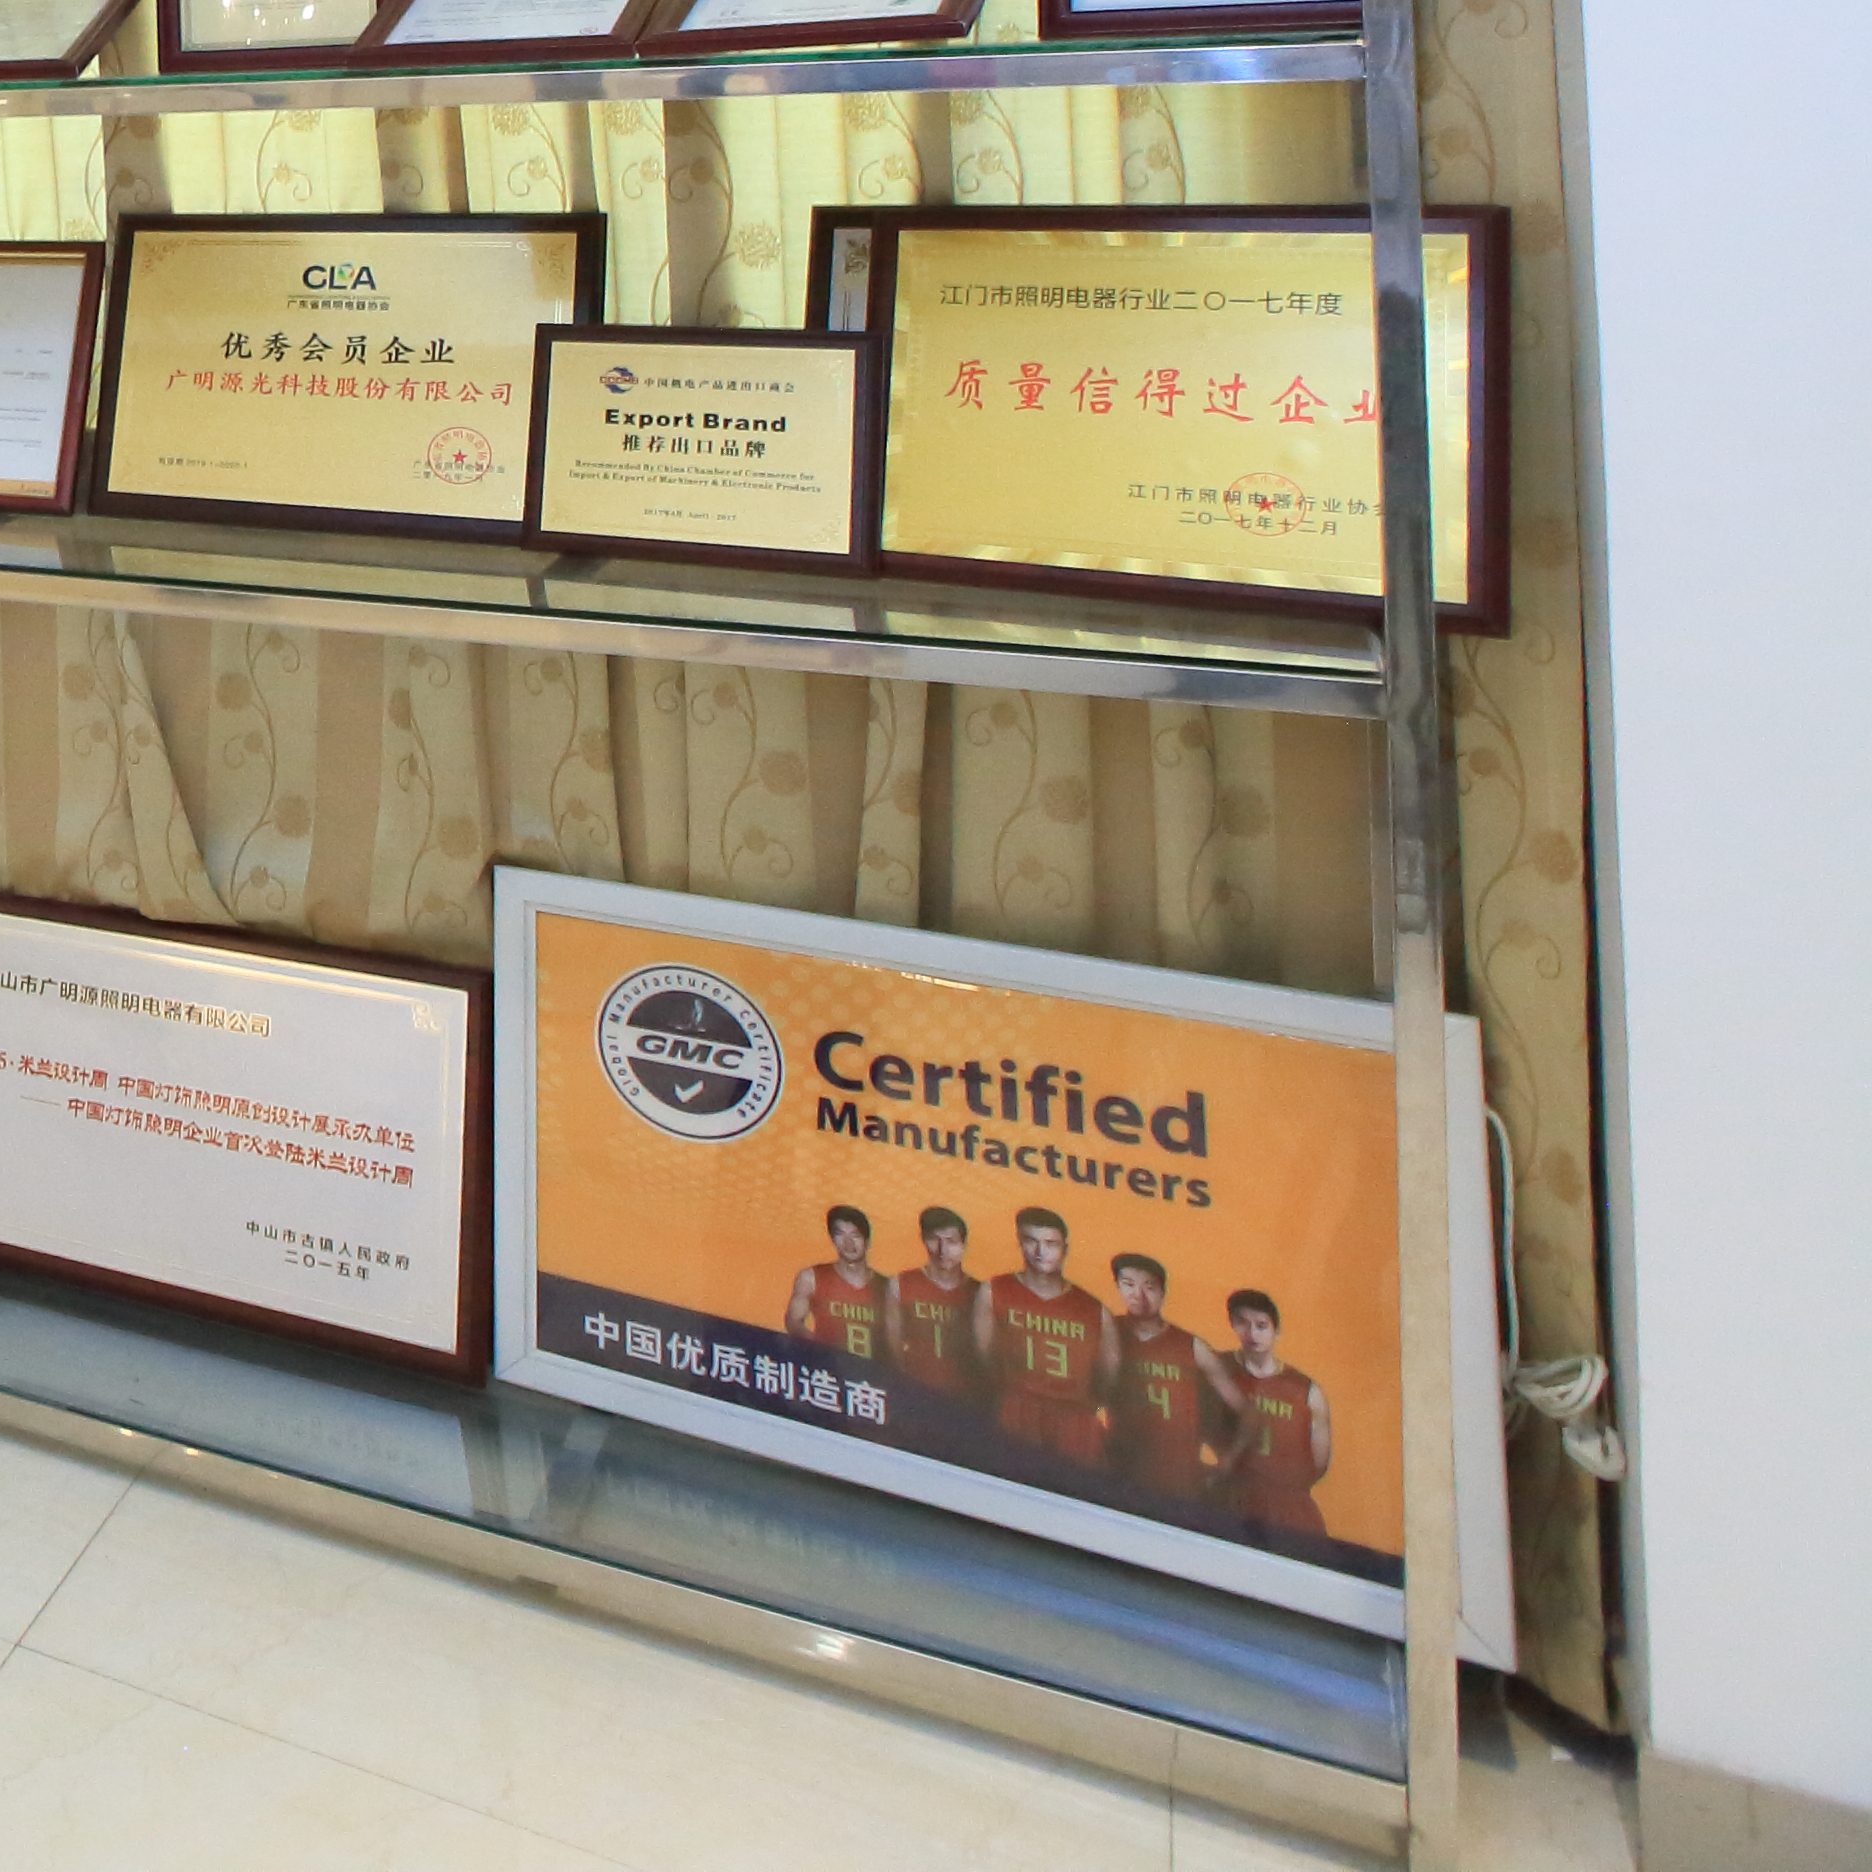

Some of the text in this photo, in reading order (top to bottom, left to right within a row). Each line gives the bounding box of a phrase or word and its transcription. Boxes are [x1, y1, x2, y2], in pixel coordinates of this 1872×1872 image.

[288, 300, 390, 312] 广东省照明电器协会
[222, 332, 455, 365] 优秀会员企业
[165, 370, 514, 406] 广明源光科技股份有限公司
[644, 378, 795, 393] 中国机电产品进出口商会
[605, 409, 787, 433] Export Brand
[622, 433, 766, 459] 推荐出口品牌
[608, 975, 732, 1024] Manufacturer
[607, 1035, 640, 1097] Global
[636, 1035, 744, 1070] GMC
[813, 1029, 1209, 1159] Certified
[117, 1074, 416, 1153] 中国灯饰照明原创设计展承办单位
[814, 1096, 1213, 1210] Manufacturers
[246, 1219, 411, 1273] 中山市古镇人民政府
[847, 1324, 872, 1359] 8
[1008, 1308, 1086, 1342] CHINA
[583, 1309, 888, 1426] 中国优质制造商
[1025, 1335, 1068, 1378] 13
[1148, 1384, 1171, 1420] 4
